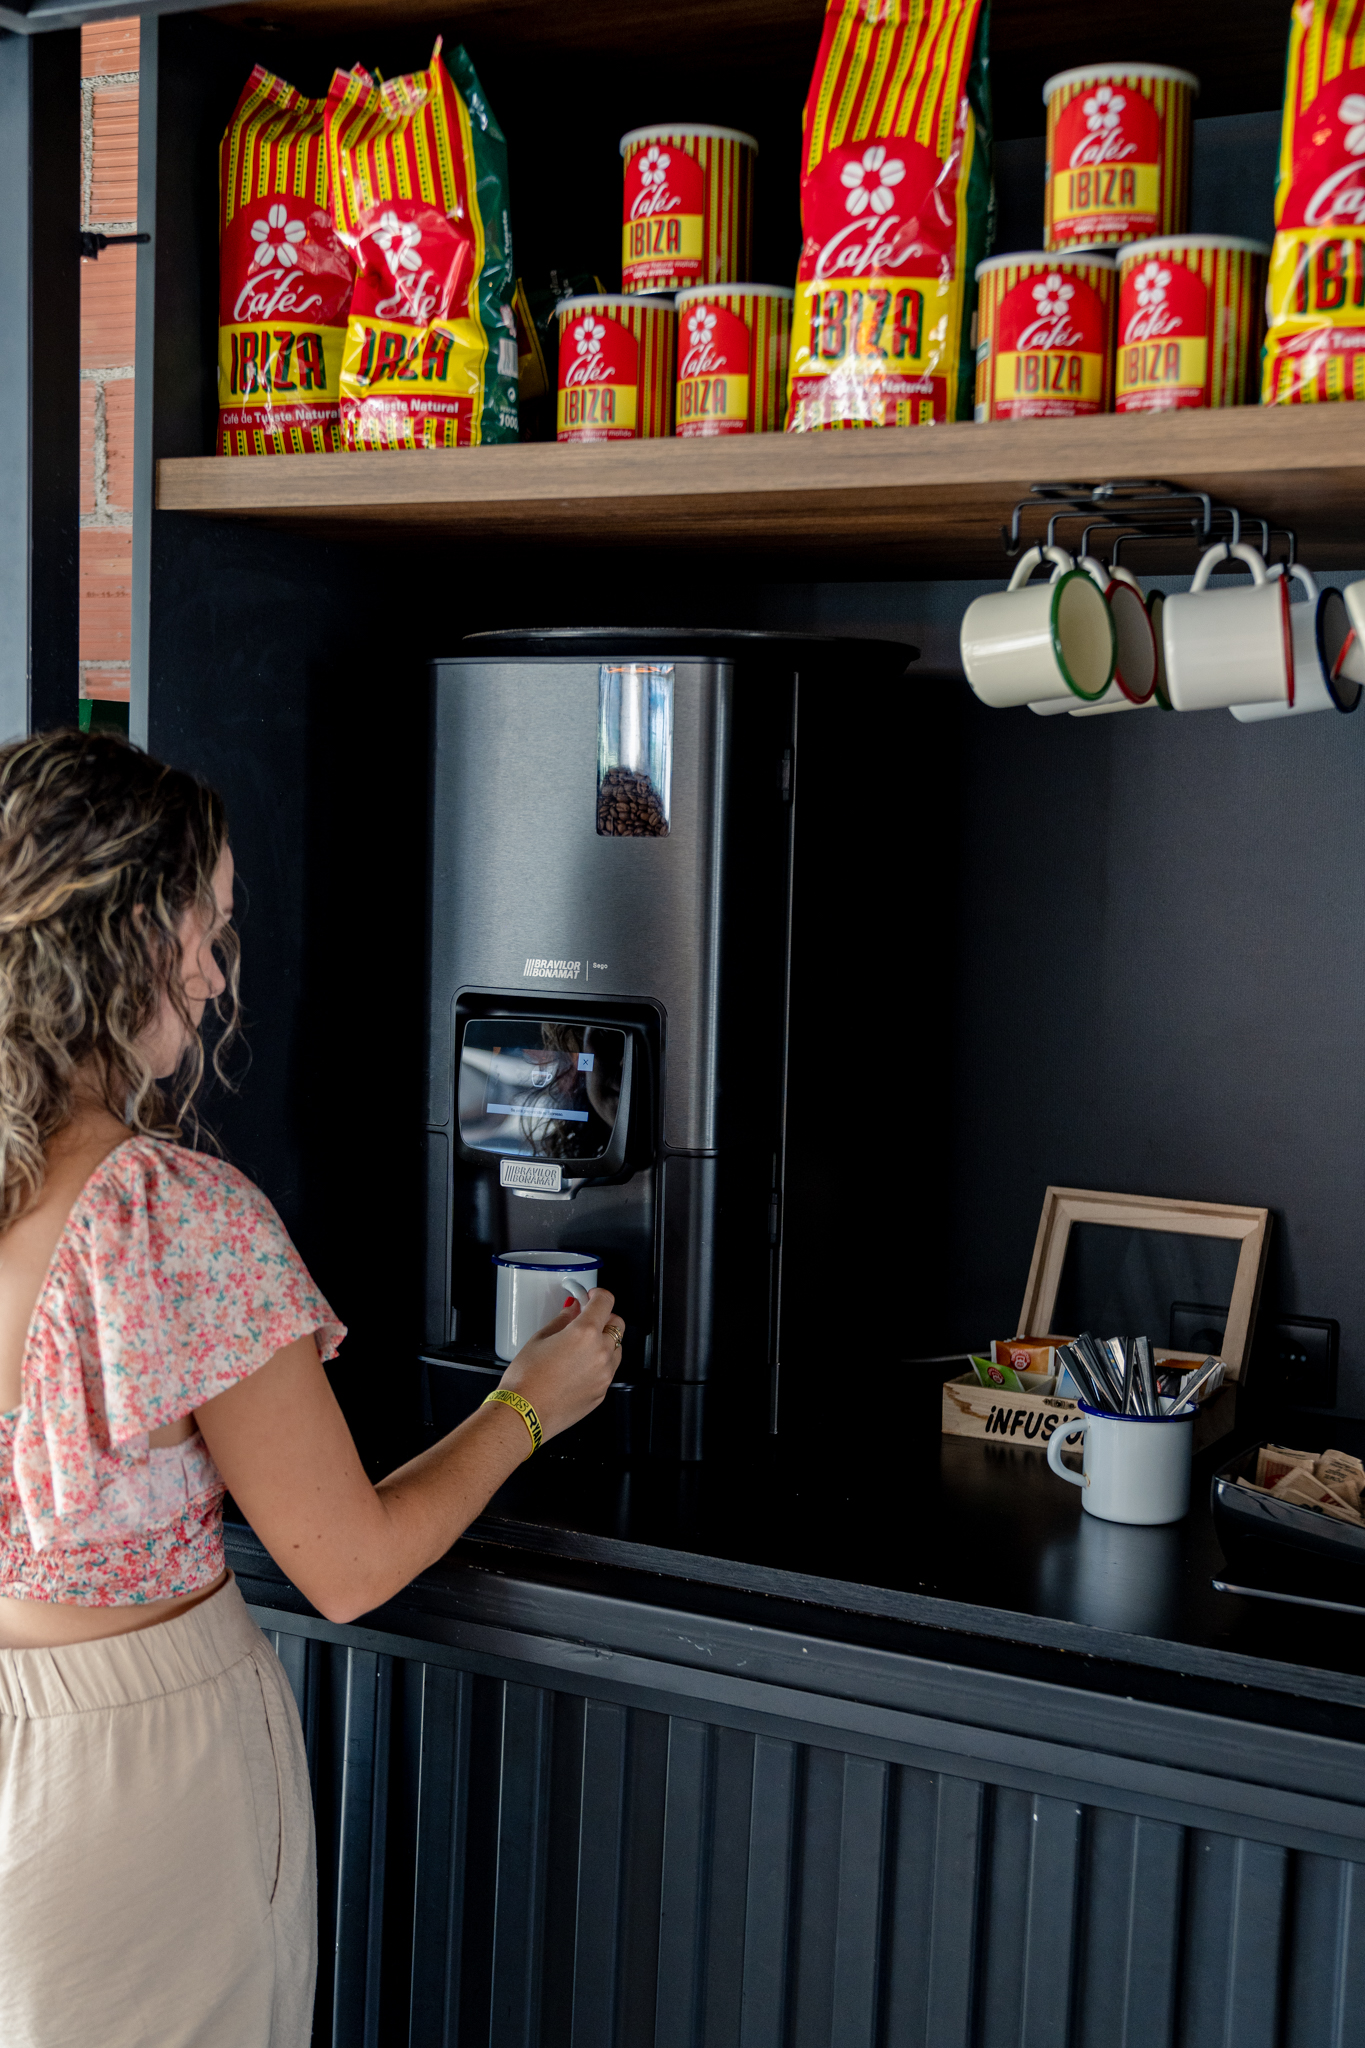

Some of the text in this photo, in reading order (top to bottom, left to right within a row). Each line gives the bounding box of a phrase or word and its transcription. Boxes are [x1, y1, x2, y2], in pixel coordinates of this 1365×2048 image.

[1068, 168, 1136, 212] IBIZA
[630, 218, 681, 259] IBIZA
[810, 288, 924, 360] IBIZA
[230, 330, 327, 395] IBIZA
[1015, 355, 1083, 395] IBIZA
[1123, 342, 1181, 388] IBIZA
[410, 399, 459, 413] Natural
[564, 388, 617, 425] IBIZA
[680, 378, 727, 418] IBIZA
[882, 381, 933, 395] Natural
[223, 411, 239, 425] Café
[241, 413, 252, 424] de
[295, 408, 340, 420] Natural
[532, 968, 580, 980] BONAMAT
[534, 959, 581, 971] BRAVILOR
[512, 1174, 555, 1187] BONAMAT
[514, 1166, 557, 1179] BRAVILOR
